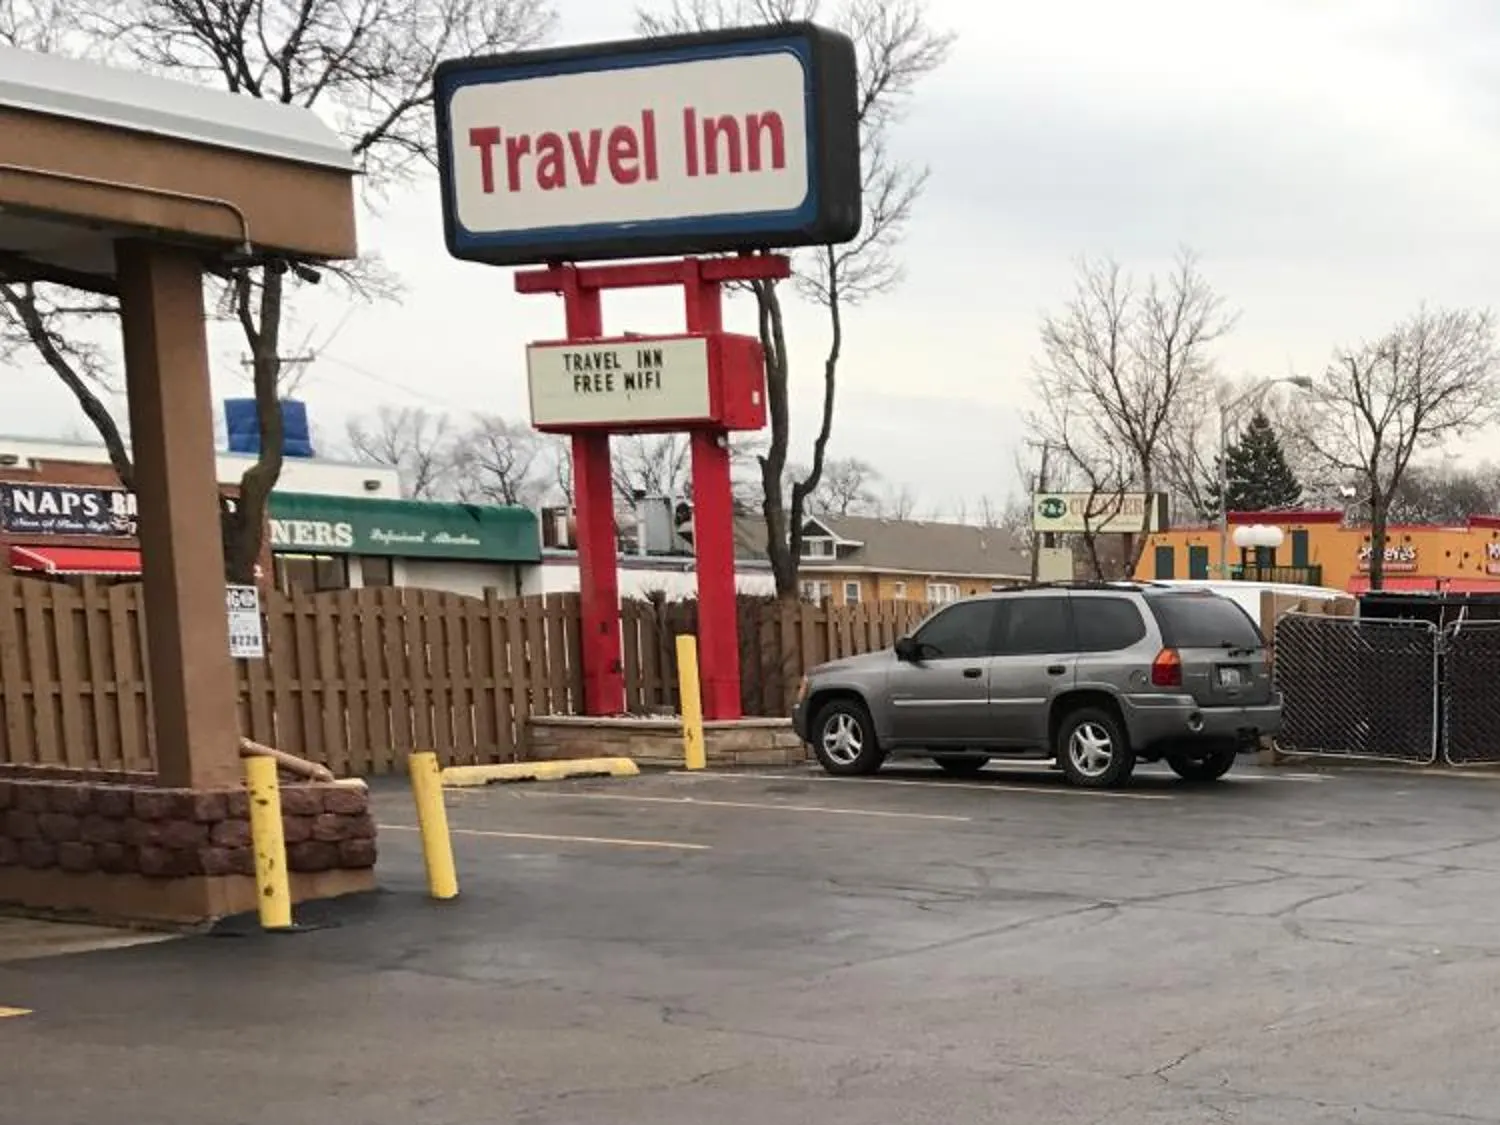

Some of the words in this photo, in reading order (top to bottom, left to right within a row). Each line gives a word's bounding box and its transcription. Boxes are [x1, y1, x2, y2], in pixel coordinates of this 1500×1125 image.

[469, 109, 659, 194] Travel
[684, 107, 786, 177] Inn
[563, 351, 622, 372] TRAVEL
[637, 349, 663, 369] INN
[573, 374, 614, 393] FREE
